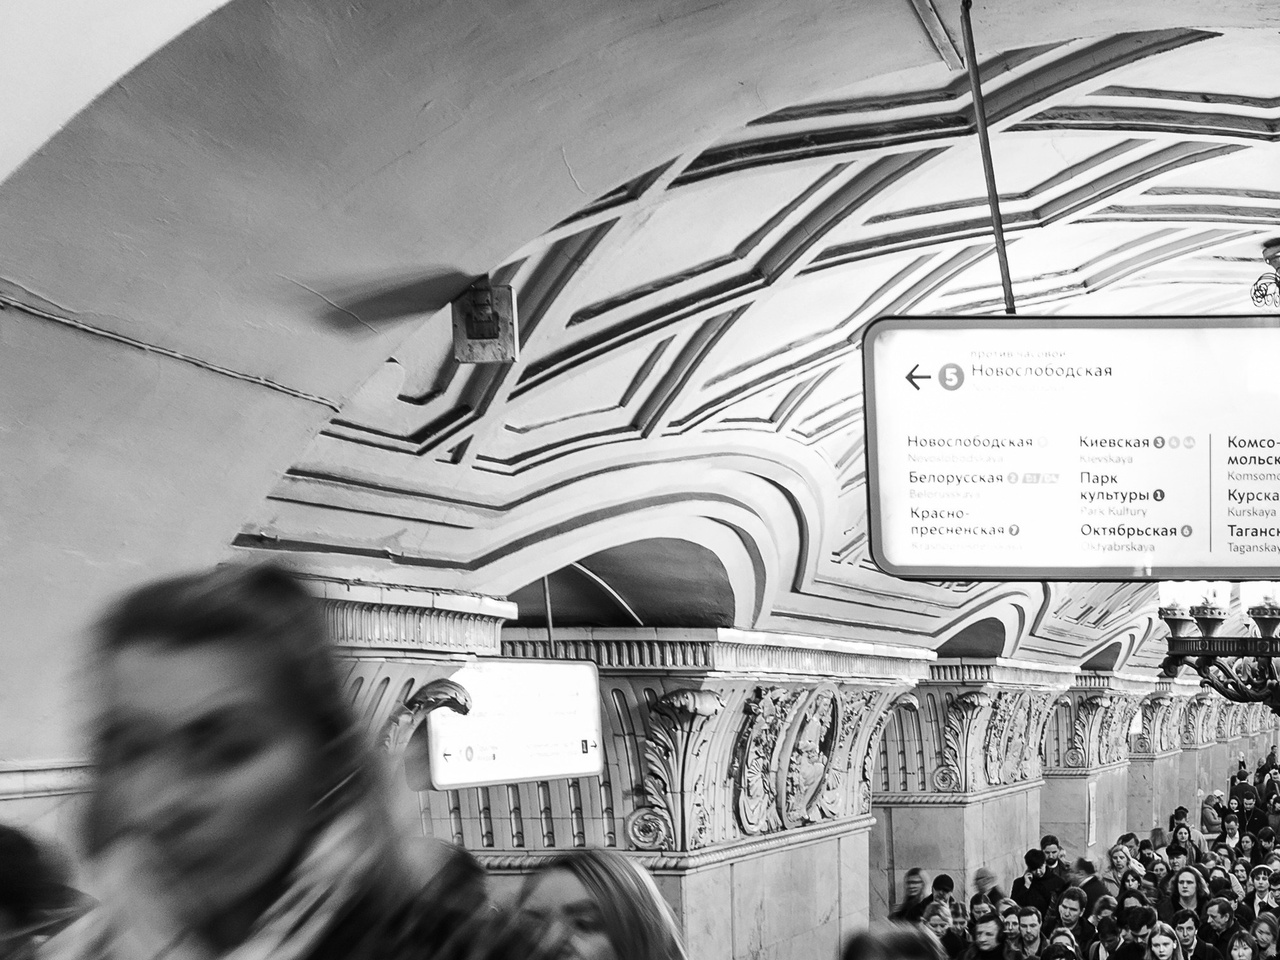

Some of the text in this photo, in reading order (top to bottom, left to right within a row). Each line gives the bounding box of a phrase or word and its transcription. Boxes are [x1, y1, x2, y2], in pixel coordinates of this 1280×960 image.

[972, 364, 1112, 378] Новослободская
[908, 436, 1032, 448] Новослободская
[1079, 436, 1150, 448] Киевская
[1228, 436, 1280, 448] Комсо-
[909, 471, 1003, 485] Белорусская
[1081, 472, 1117, 486] Парк
[1081, 492, 1149, 503] культуры
[911, 507, 970, 520] Красно-
[1228, 507, 1276, 518] Kurskaya
[911, 526, 1005, 538] пресненская
[1081, 524, 1177, 539] Октябрьская
